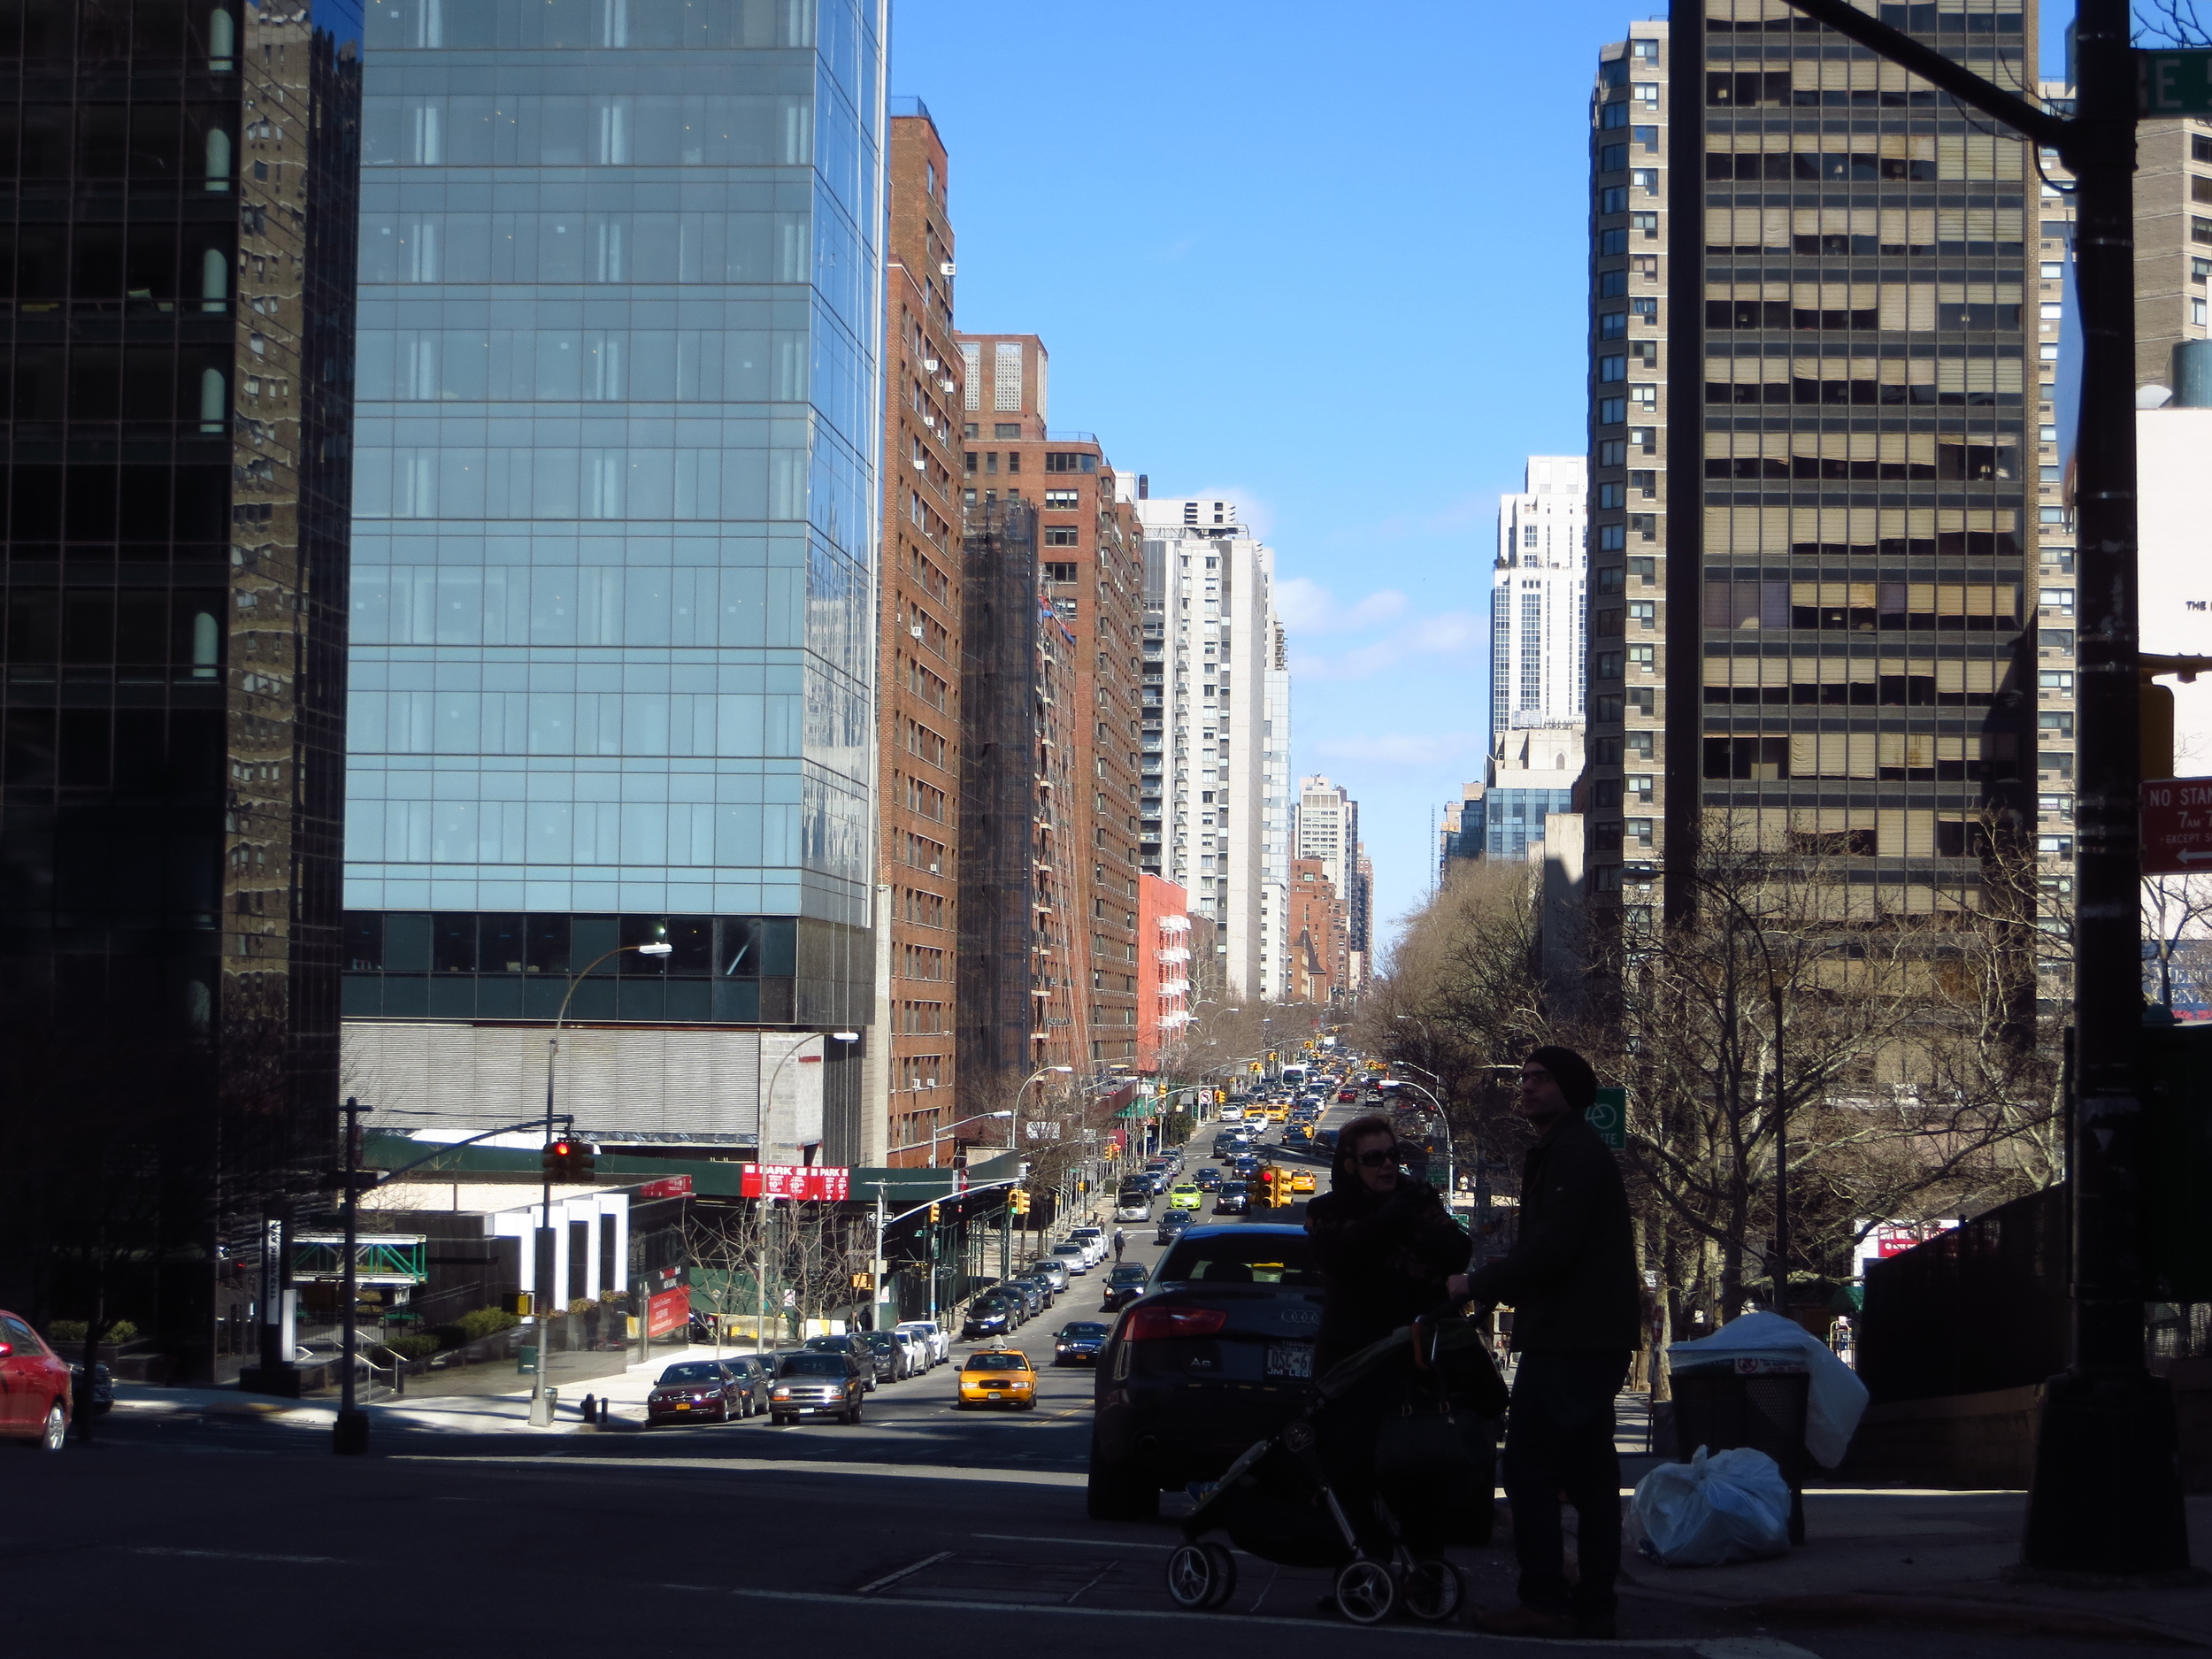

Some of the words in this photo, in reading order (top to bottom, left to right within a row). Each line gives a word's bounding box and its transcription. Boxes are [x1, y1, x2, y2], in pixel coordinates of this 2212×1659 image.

[2156, 59, 2182, 108] E
[2185, 601, 2207, 611] THE
[2150, 788, 2171, 806] NO
[2165, 833, 2200, 844] EXCEPT
[820, 1168, 840, 1177] PARK
[1190, 1357, 1211, 1367] A6
